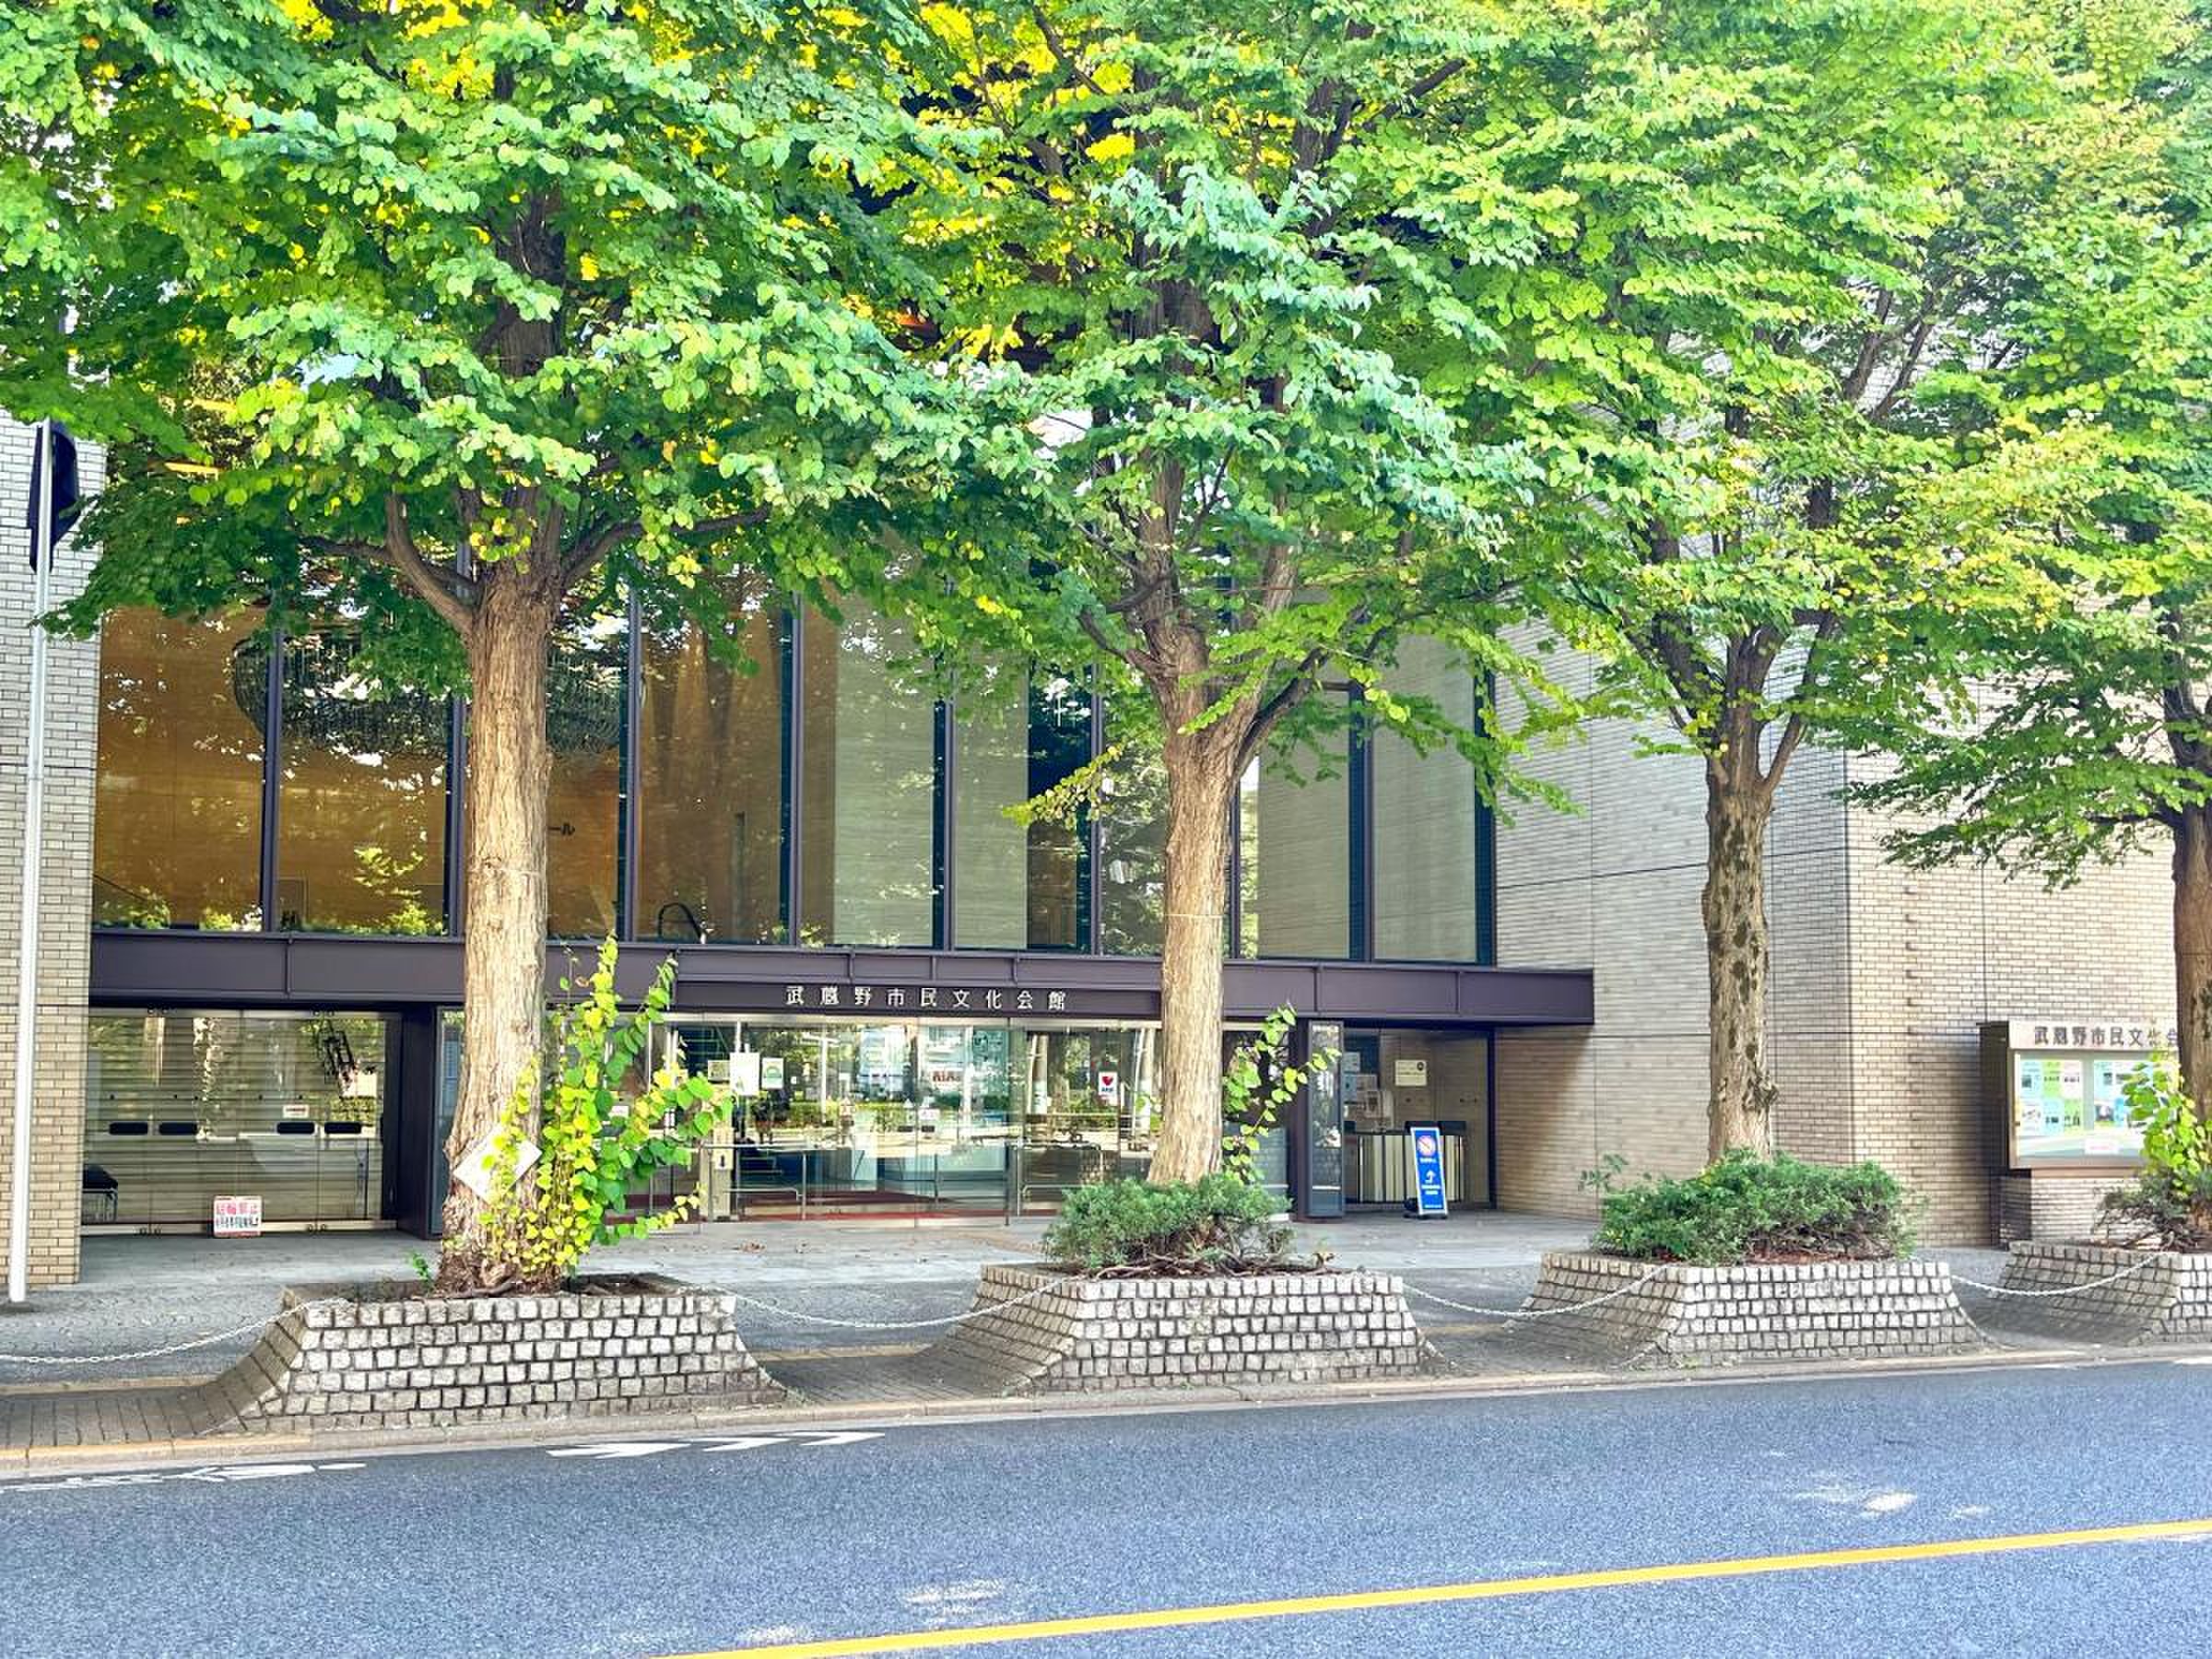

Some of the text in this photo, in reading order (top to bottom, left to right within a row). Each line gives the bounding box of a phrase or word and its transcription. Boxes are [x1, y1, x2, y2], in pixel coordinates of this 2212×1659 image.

[785, 985, 1066, 1010] 武蔵野市民文化会館
